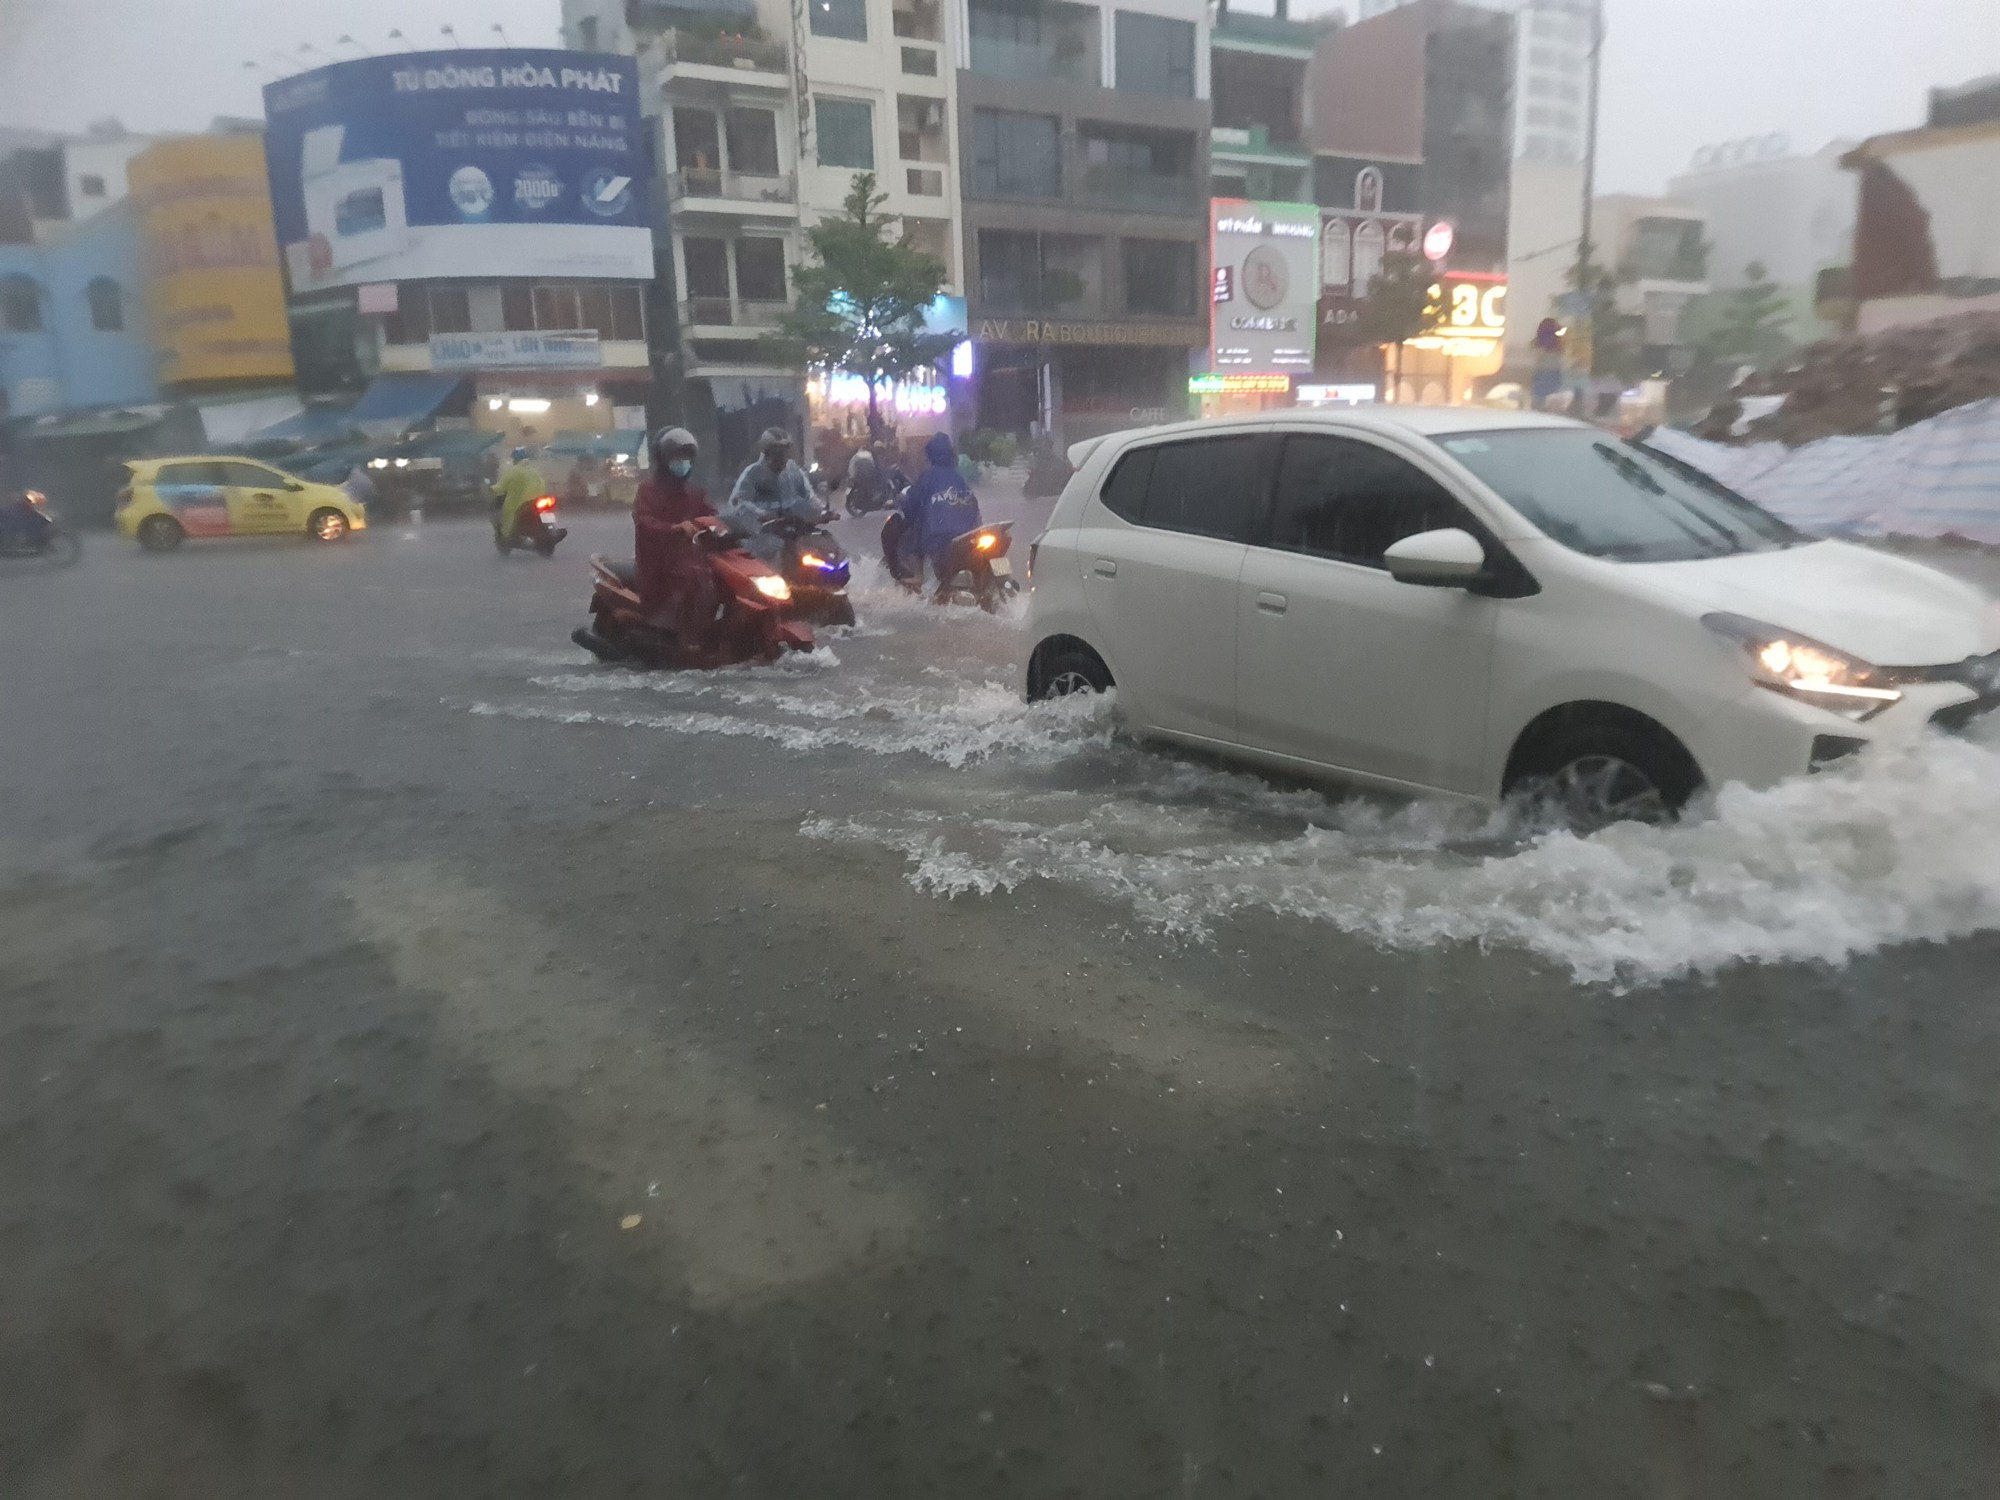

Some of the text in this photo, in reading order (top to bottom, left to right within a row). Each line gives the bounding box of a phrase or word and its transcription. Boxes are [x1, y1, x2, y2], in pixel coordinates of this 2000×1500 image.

[424, 64, 496, 89] ĐÔNG
[501, 62, 556, 88] HÒA
[560, 66, 622, 93] PHÁT
